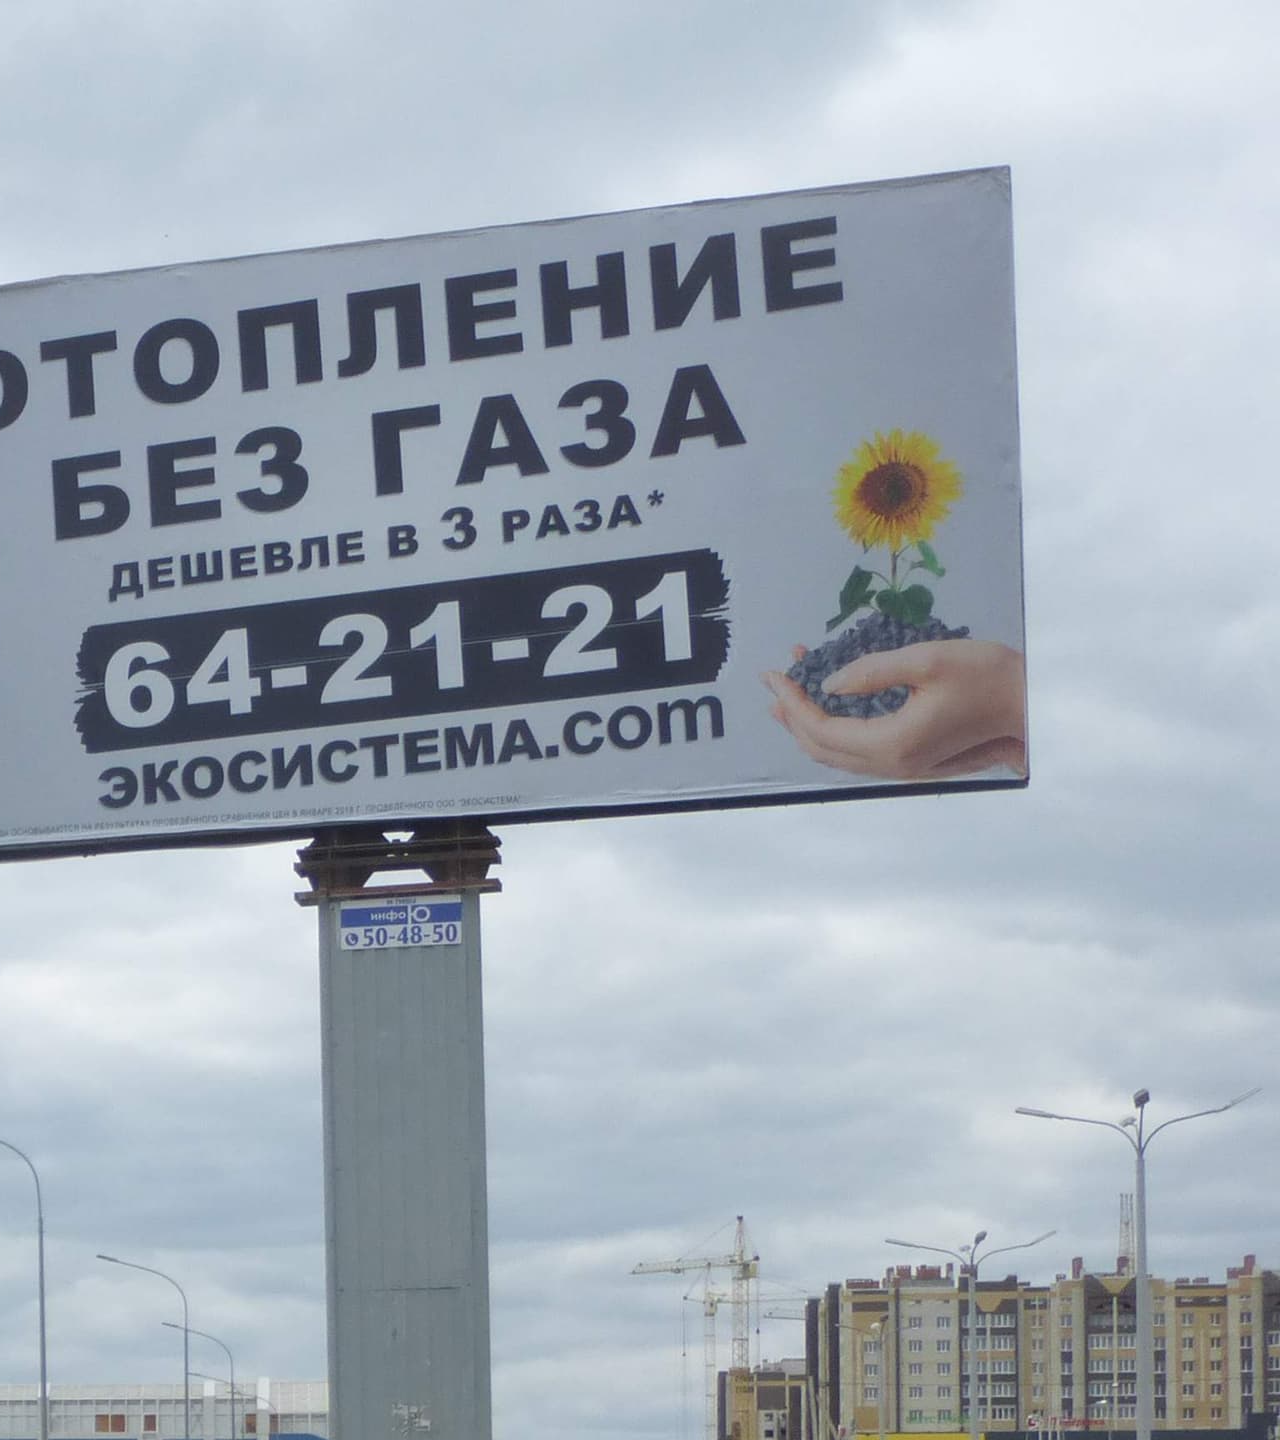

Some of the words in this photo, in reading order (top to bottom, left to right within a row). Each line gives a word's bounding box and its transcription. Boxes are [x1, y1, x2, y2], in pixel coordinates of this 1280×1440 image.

[52, 427, 308, 541] БЕЗ
[372, 364, 746, 497] ГАЗА
[108, 530, 365, 602] ДЕШЕВЛЕ
[387, 524, 419, 559] В
[440, 506, 478, 551] 3
[103, 570, 694, 728] 64-21-21
[97, 695, 726, 809] ЭКОСИСТЕМА.com
[362, 924, 458, 947] 50-48-50
